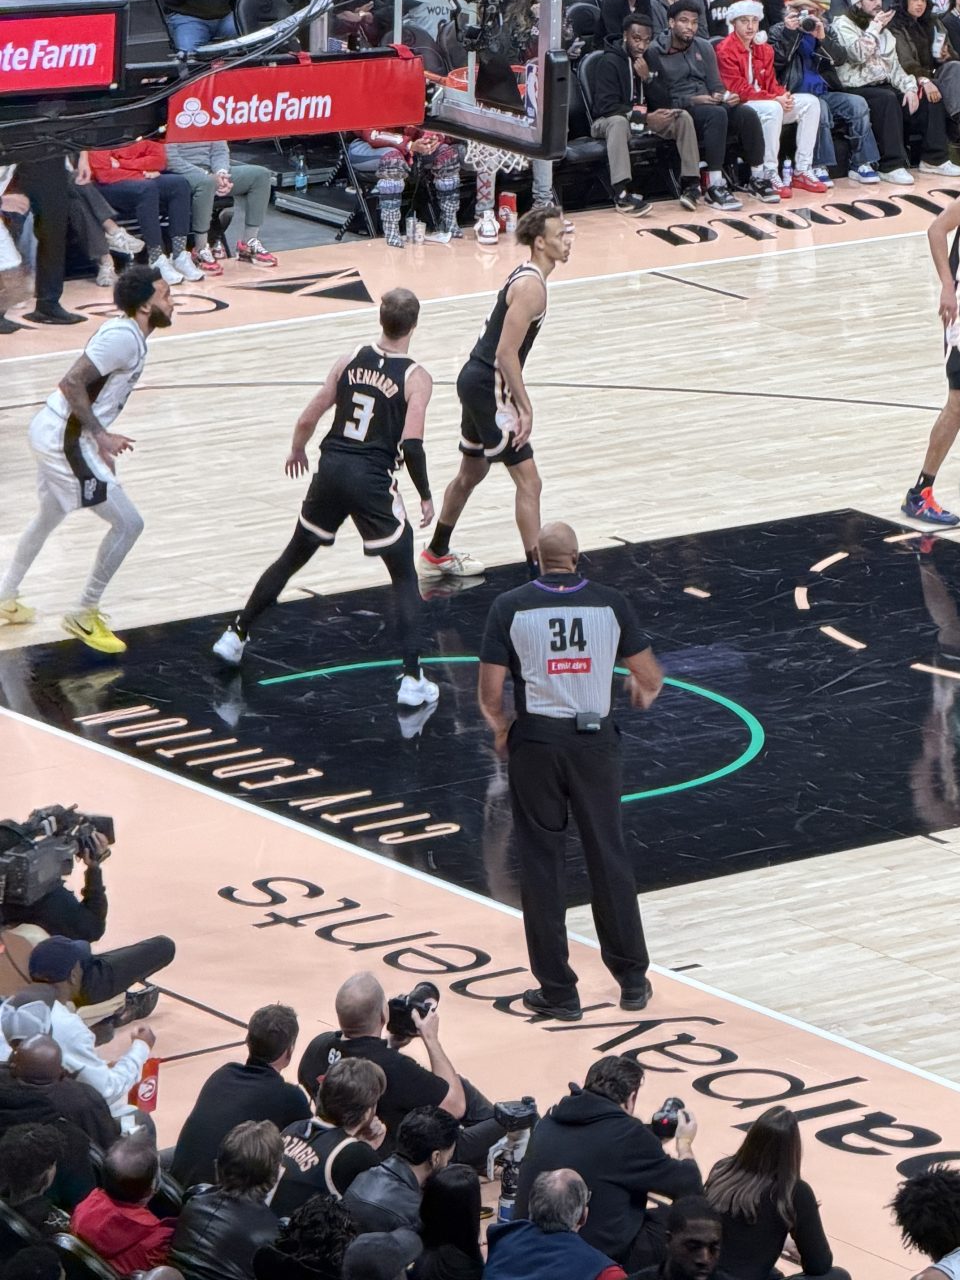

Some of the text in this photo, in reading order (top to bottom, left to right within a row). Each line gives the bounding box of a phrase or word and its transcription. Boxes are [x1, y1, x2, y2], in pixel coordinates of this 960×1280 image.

[348, 368, 399, 399] KENNARD
[343, 391, 376, 442] 3
[548, 617, 587, 652] 34
[72, 704, 461, 845] CITY EDITION
